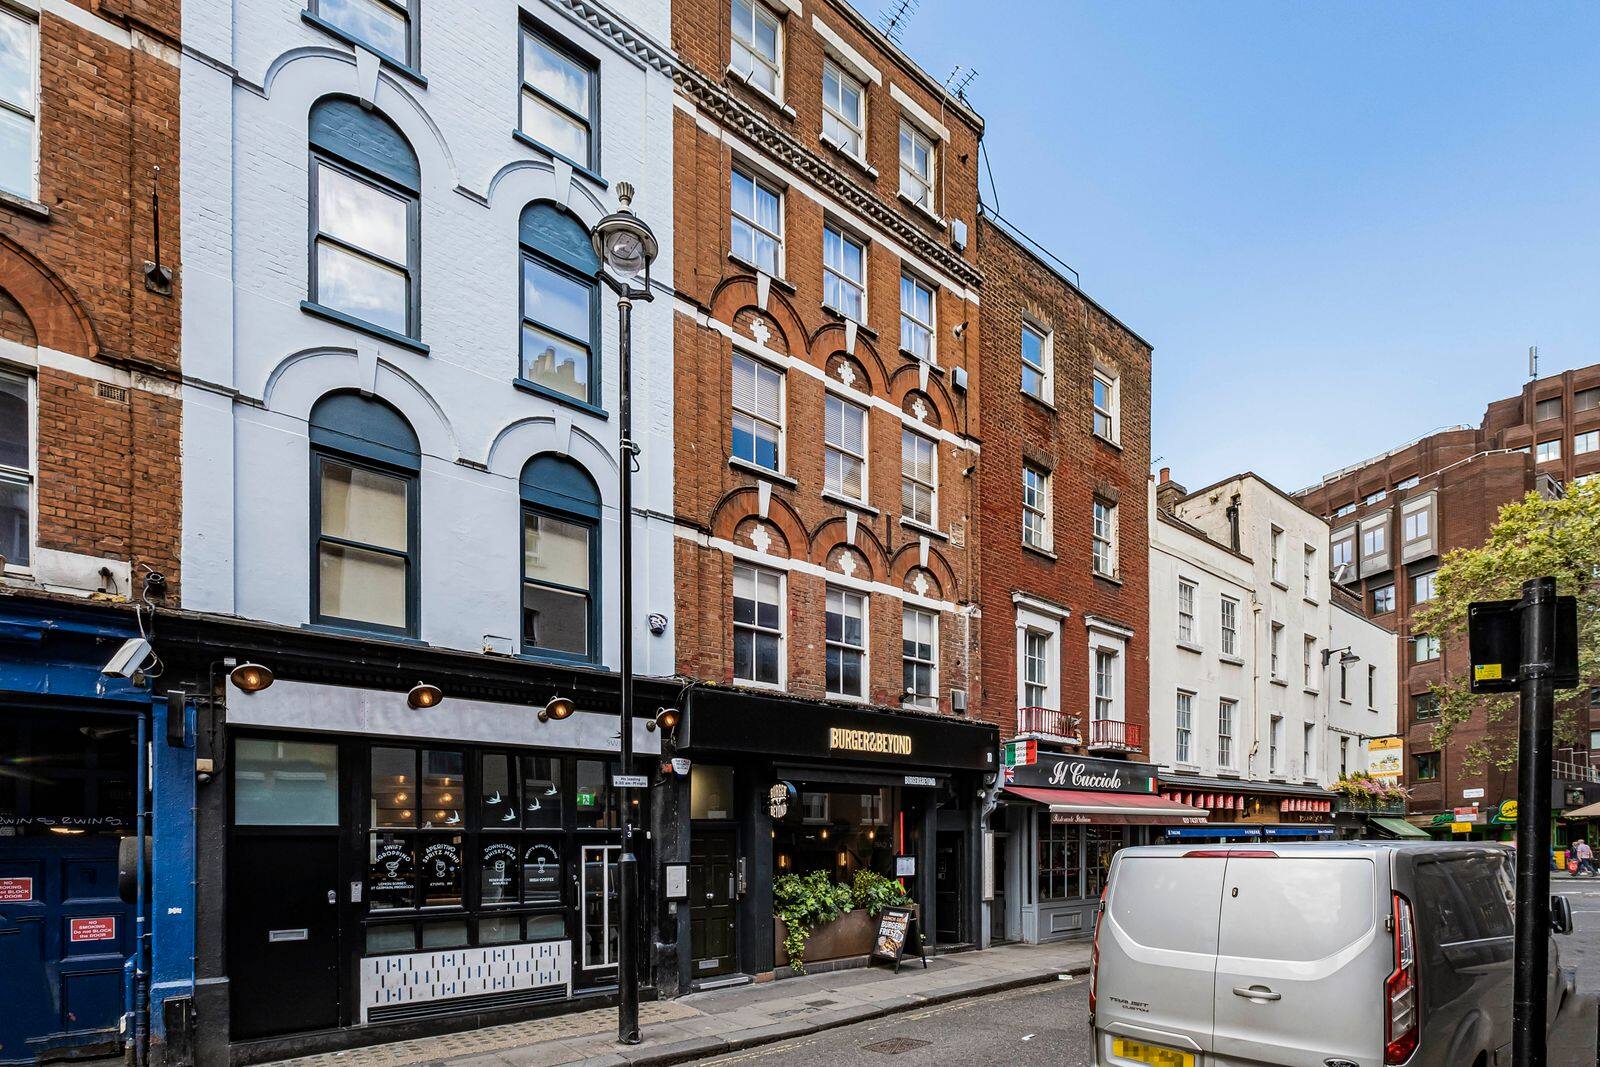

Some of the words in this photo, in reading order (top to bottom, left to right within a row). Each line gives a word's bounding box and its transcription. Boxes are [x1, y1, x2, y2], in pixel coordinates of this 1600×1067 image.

[830, 727, 912, 755] BURGER&BEYOND
[1048, 761, 1069, 785] Il
[1069, 762, 1122, 789] Cucciolo
[484, 843, 516, 853] DOWNSTAIRS
[484, 849, 505, 860] WHISKY
